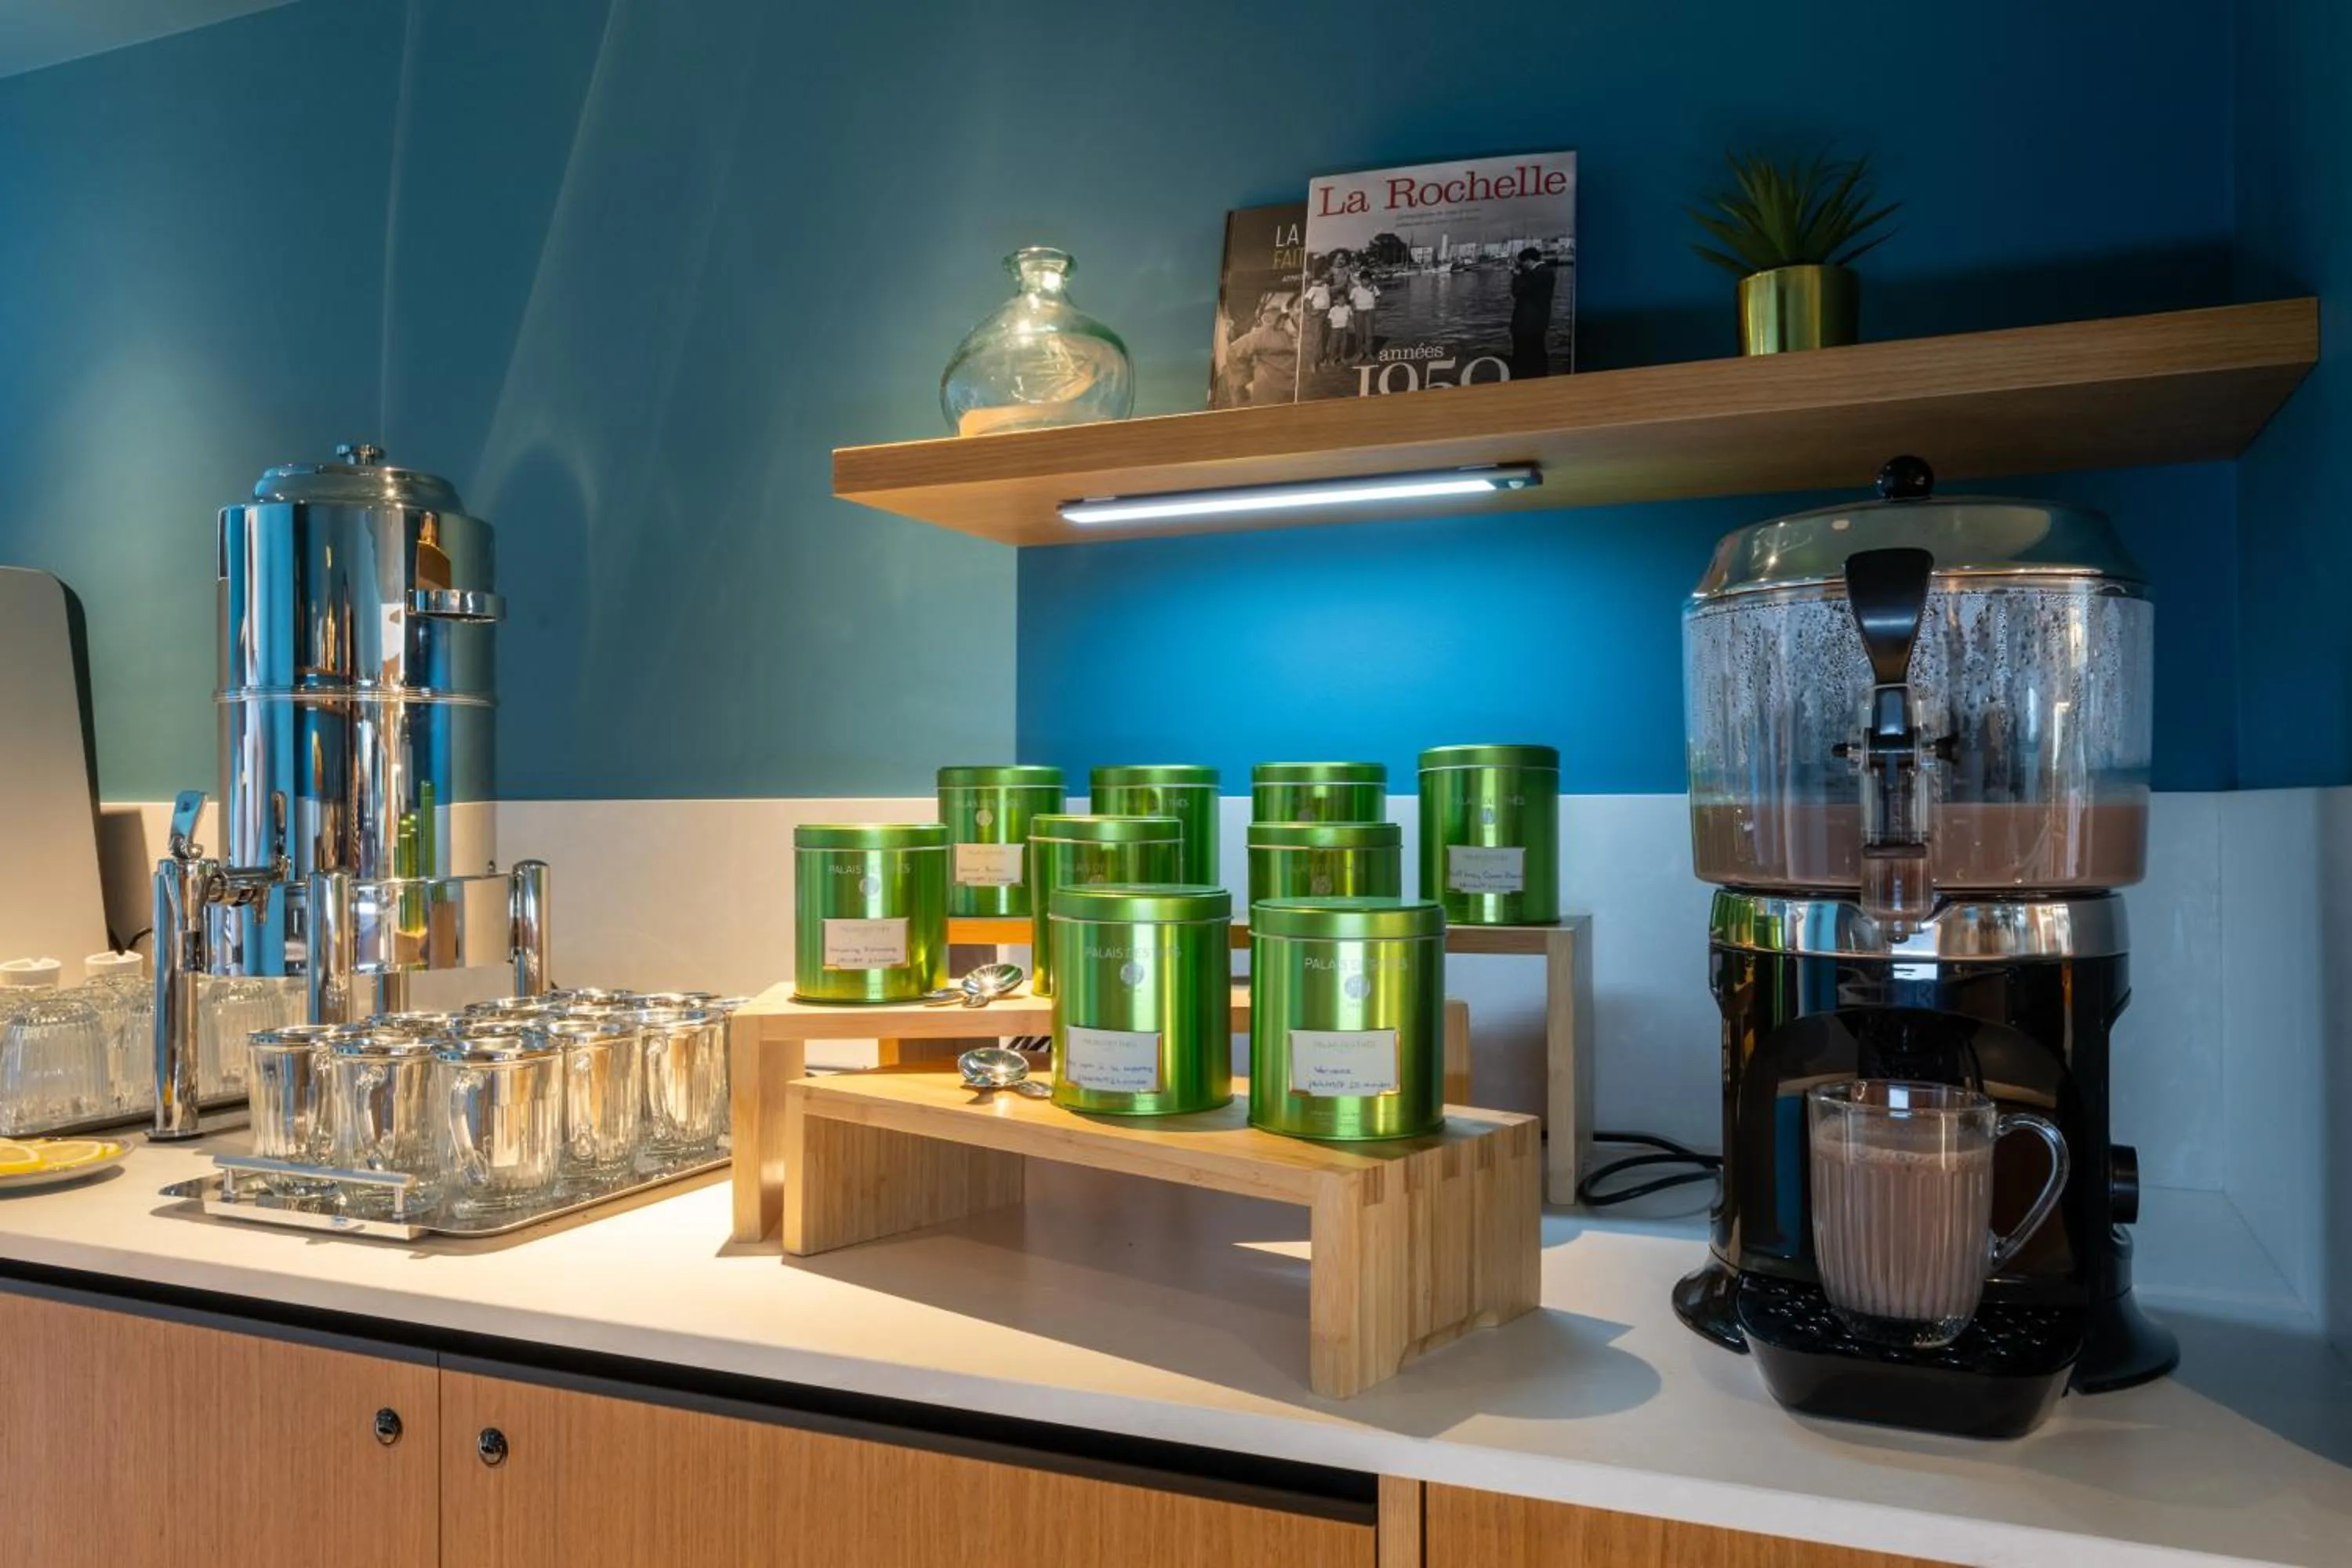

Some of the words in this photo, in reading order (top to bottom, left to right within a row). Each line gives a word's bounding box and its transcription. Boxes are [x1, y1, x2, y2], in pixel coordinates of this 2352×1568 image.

[1318, 186, 1369, 216] La
[1385, 165, 1567, 209] Rochelle
[1276, 223, 1299, 247] LA
[1378, 343, 1445, 361] années
[828, 864, 862, 874] PALAIS
[1085, 946, 1124, 959] PALAIS
